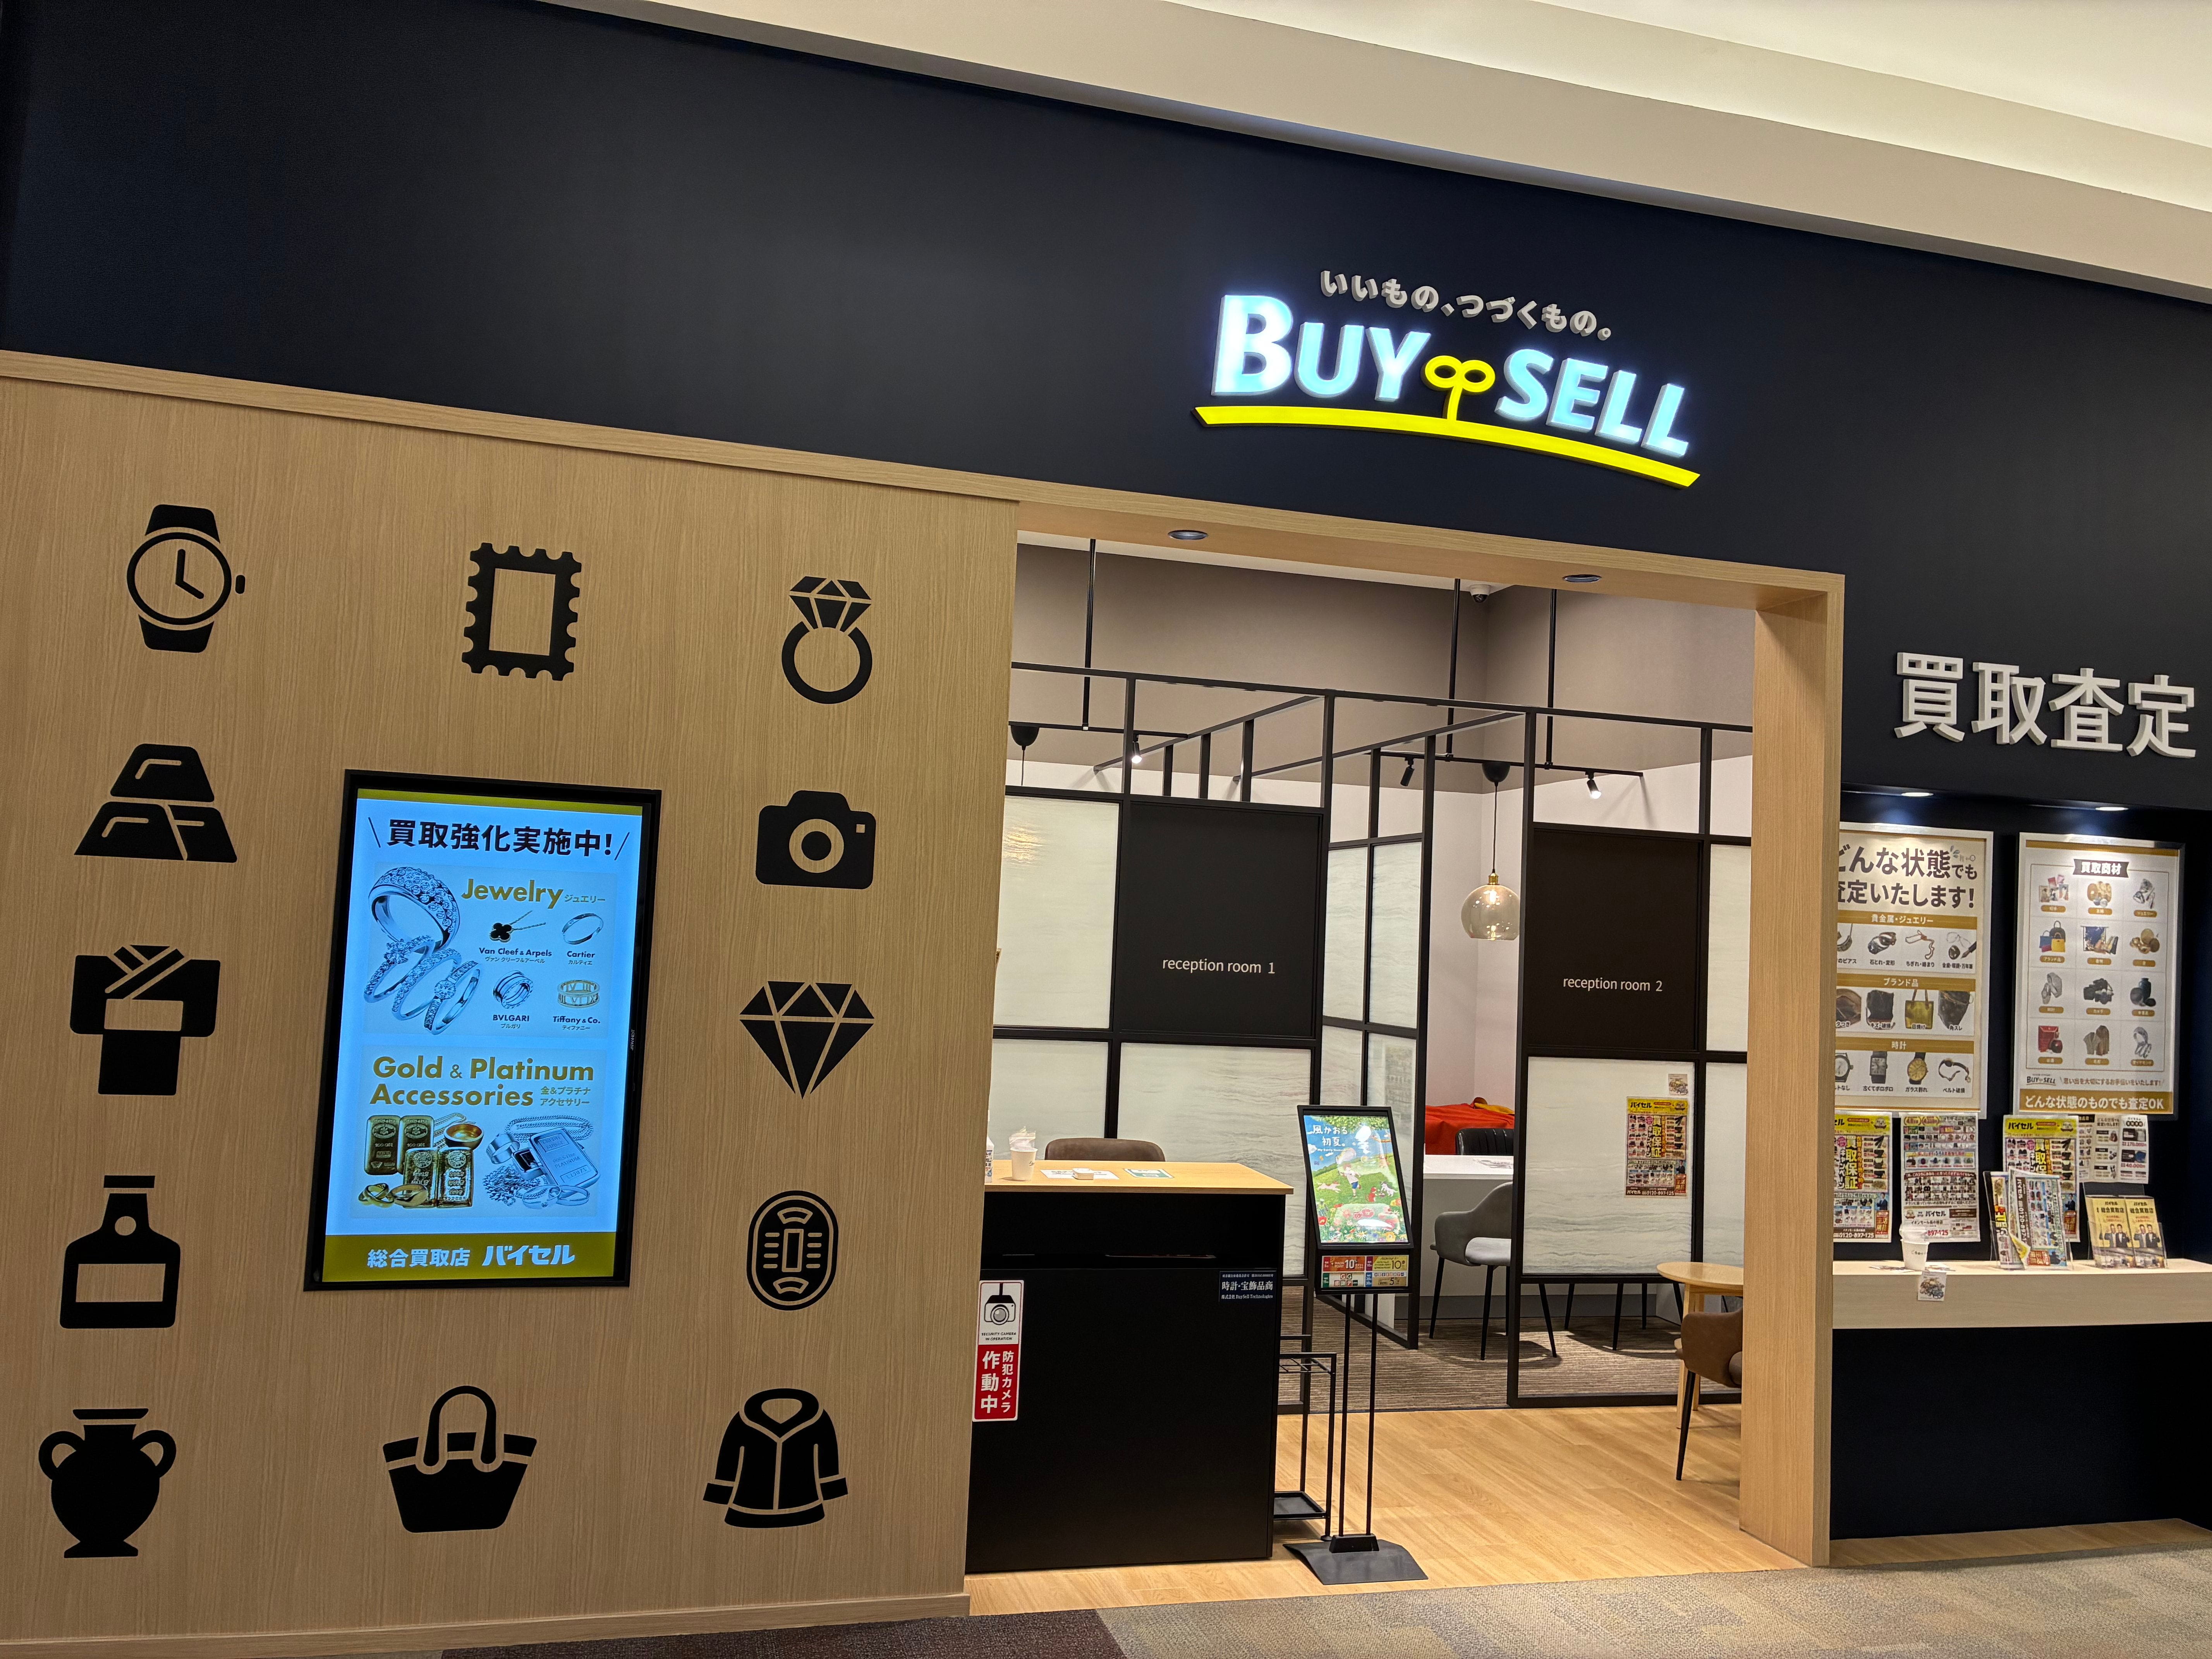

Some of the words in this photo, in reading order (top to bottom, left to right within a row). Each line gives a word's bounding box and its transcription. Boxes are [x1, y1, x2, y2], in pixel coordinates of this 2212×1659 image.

[1320, 270, 1611, 341] いいもの、つづくもの。
[1211, 294, 1431, 402] BUY
[1494, 349, 1689, 457] SELL
[1894, 652, 2196, 759] 買取査定
[387, 819, 612, 857] 買取強化実施中!
[2081, 862, 2122, 875] 買取商材
[461, 879, 564, 909] Jewelry
[564, 895, 606, 903] ジュエリー
[1871, 913, 1934, 924] 貴金属・ジュエリー
[1163, 958, 1223, 974] reception
[1228, 962, 1261, 973] room
[1268, 962, 1275, 974] 1
[1563, 977, 1617, 992] reception
[1621, 981, 1650, 991] room
[1656, 980, 1663, 992] 2
[1883, 978, 1918, 987] ブランド品
[553, 1016, 580, 1024] Tiffany
[1891, 1041, 1907, 1050] 時計
[373, 1055, 443, 1079] Gold
[449, 1064, 463, 1079] &
[470, 1057, 594, 1081] Platinum
[370, 1084, 534, 1106] Accessories
[540, 1086, 591, 1095] 金&プラチナ
[540, 1098, 590, 1107] アクセサリー
[2026, 1095, 2164, 1110] どんな状態のものでも査定OK
[1313, 1125, 1348, 1134] 風かおる
[1651, 1115, 1662, 1158] 買取保証
[1322, 1136, 1345, 1146] 初夏。
[368, 1248, 470, 1268] 総合買取店
[482, 1245, 575, 1266] バイセル
[1345, 1259, 1355, 1269] 10
[1391, 1261, 1401, 1269] 10
[1222, 1280, 1273, 1290] 時計・宝飾品商
[981, 1351, 1001, 1414] 作動中
[1001, 1350, 1014, 1413] 防犯カメラ
